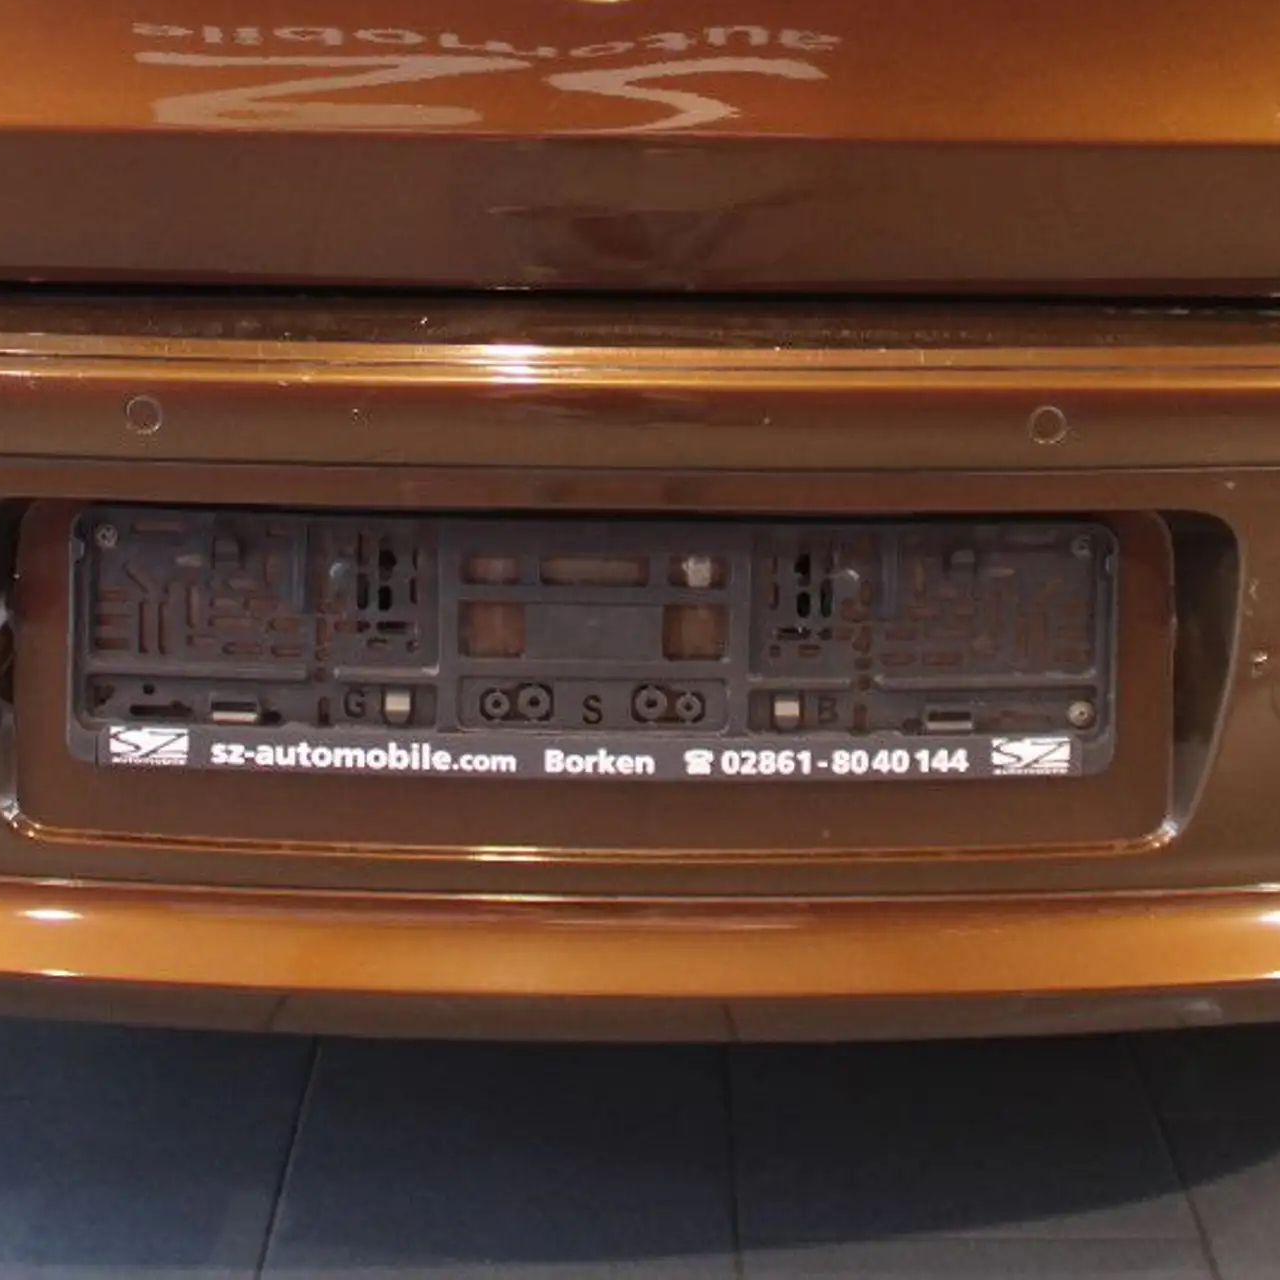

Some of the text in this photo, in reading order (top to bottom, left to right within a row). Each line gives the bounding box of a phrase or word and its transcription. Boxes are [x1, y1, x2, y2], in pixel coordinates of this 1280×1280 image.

[344, 689, 366, 719] G
[582, 695, 603, 724] S
[210, 741, 517, 773] sz-automobile.com
[544, 747, 656, 775] Borken
